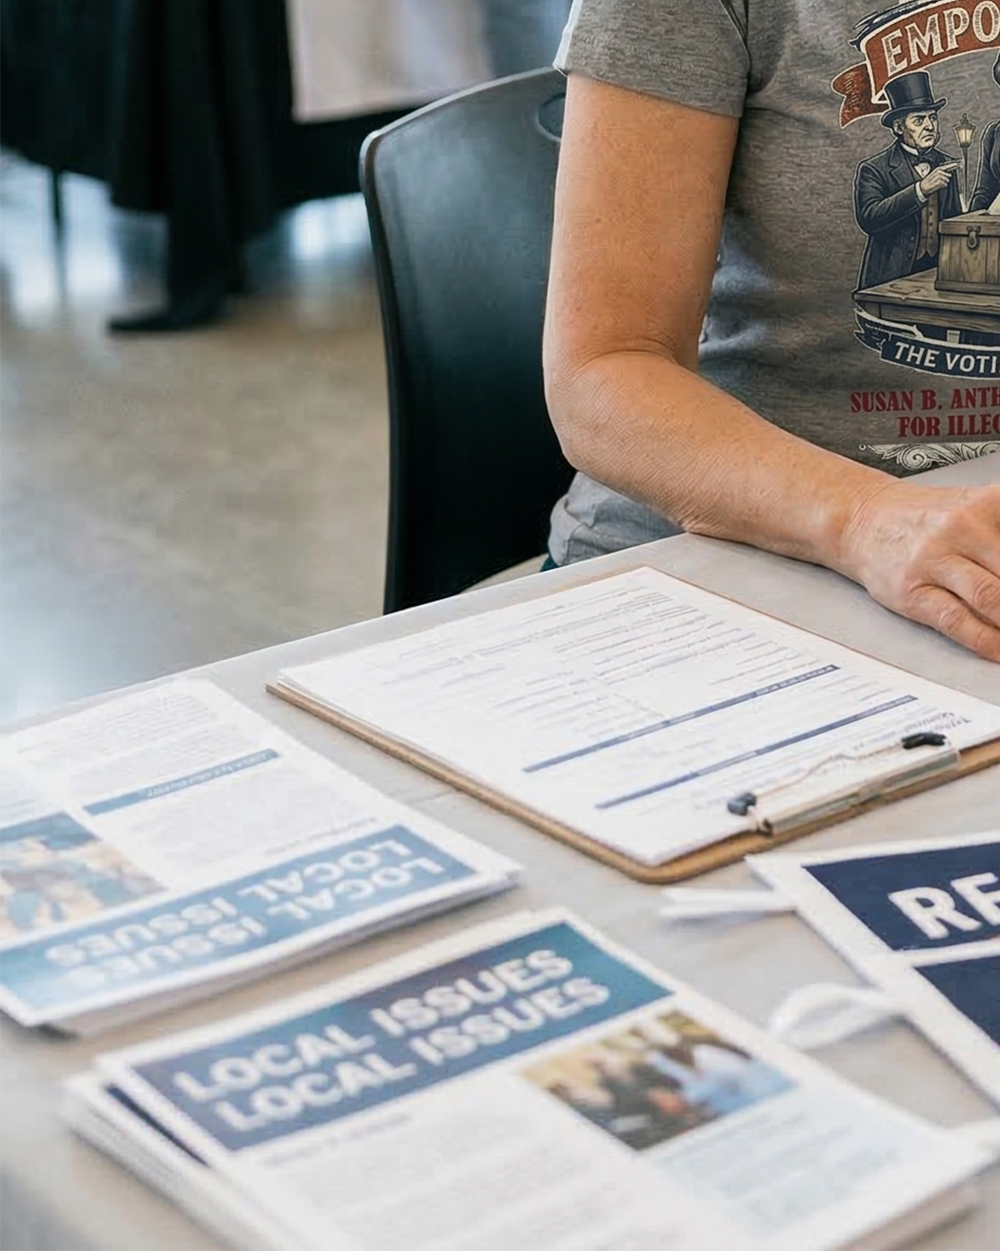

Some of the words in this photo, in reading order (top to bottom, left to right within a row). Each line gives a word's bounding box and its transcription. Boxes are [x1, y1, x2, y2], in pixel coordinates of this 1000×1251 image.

[894, 341, 936, 368] THE
[850, 390, 914, 413] SUSAN
[920, 388, 942, 411] B.
[898, 414, 941, 438] FOR
[238, 839, 413, 897] LOCAL
[266, 857, 445, 920] LOCAL
[45, 897, 238, 968] ISSUES
[67, 916, 267, 989] ISSUES
[172, 1024, 376, 1103] LOCAL
[370, 948, 574, 1038] ISSUES
[214, 1053, 418, 1133] LOCAL
[409, 977, 611, 1067] ISSUES
